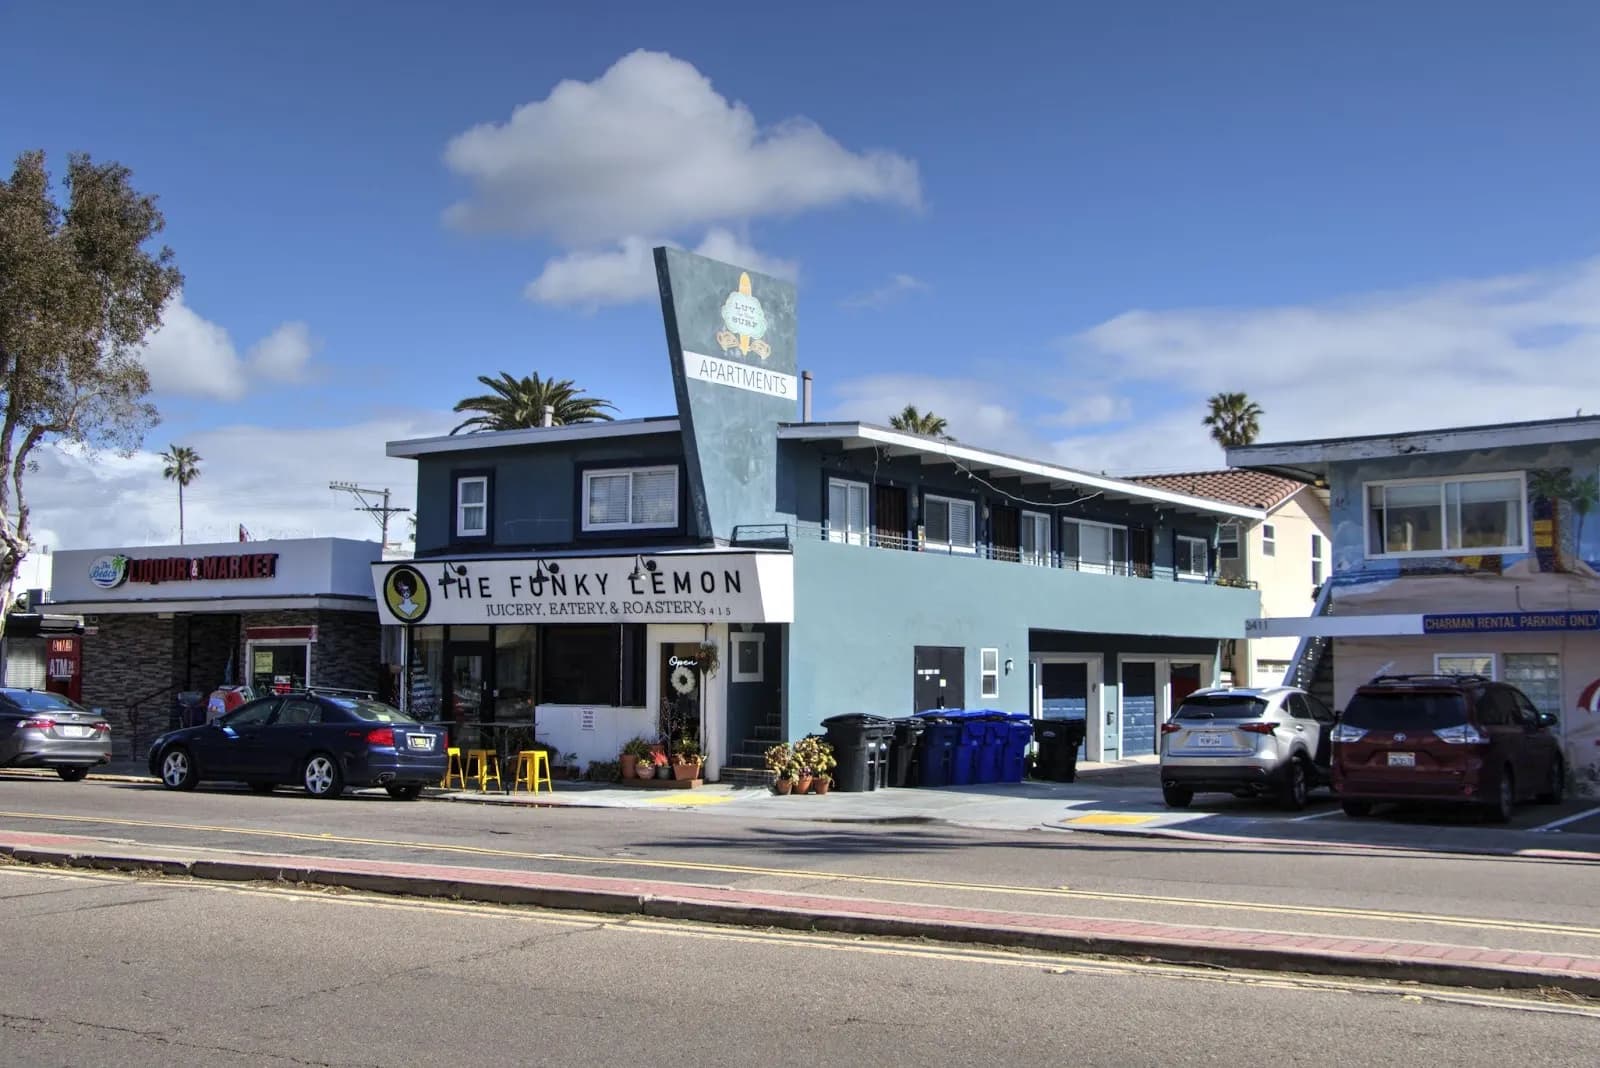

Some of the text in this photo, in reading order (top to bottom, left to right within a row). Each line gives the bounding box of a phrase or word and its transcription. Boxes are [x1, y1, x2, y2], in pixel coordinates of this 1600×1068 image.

[700, 359, 787, 394] APARTMENTS
[90, 567, 117, 580] Beach
[129, 554, 276, 584] LIQUOR & MARKET
[438, 570, 742, 600] THE FUNKY LEMON
[610, 602, 618, 614] &
[623, 600, 703, 614] ROASTERY
[700, 607, 731, 616] 3415
[1425, 614, 1598, 630] CHARMAN RENTAL PARKING ONLY
[50, 659, 68, 675] ATM
[669, 656, 698, 669] Open
